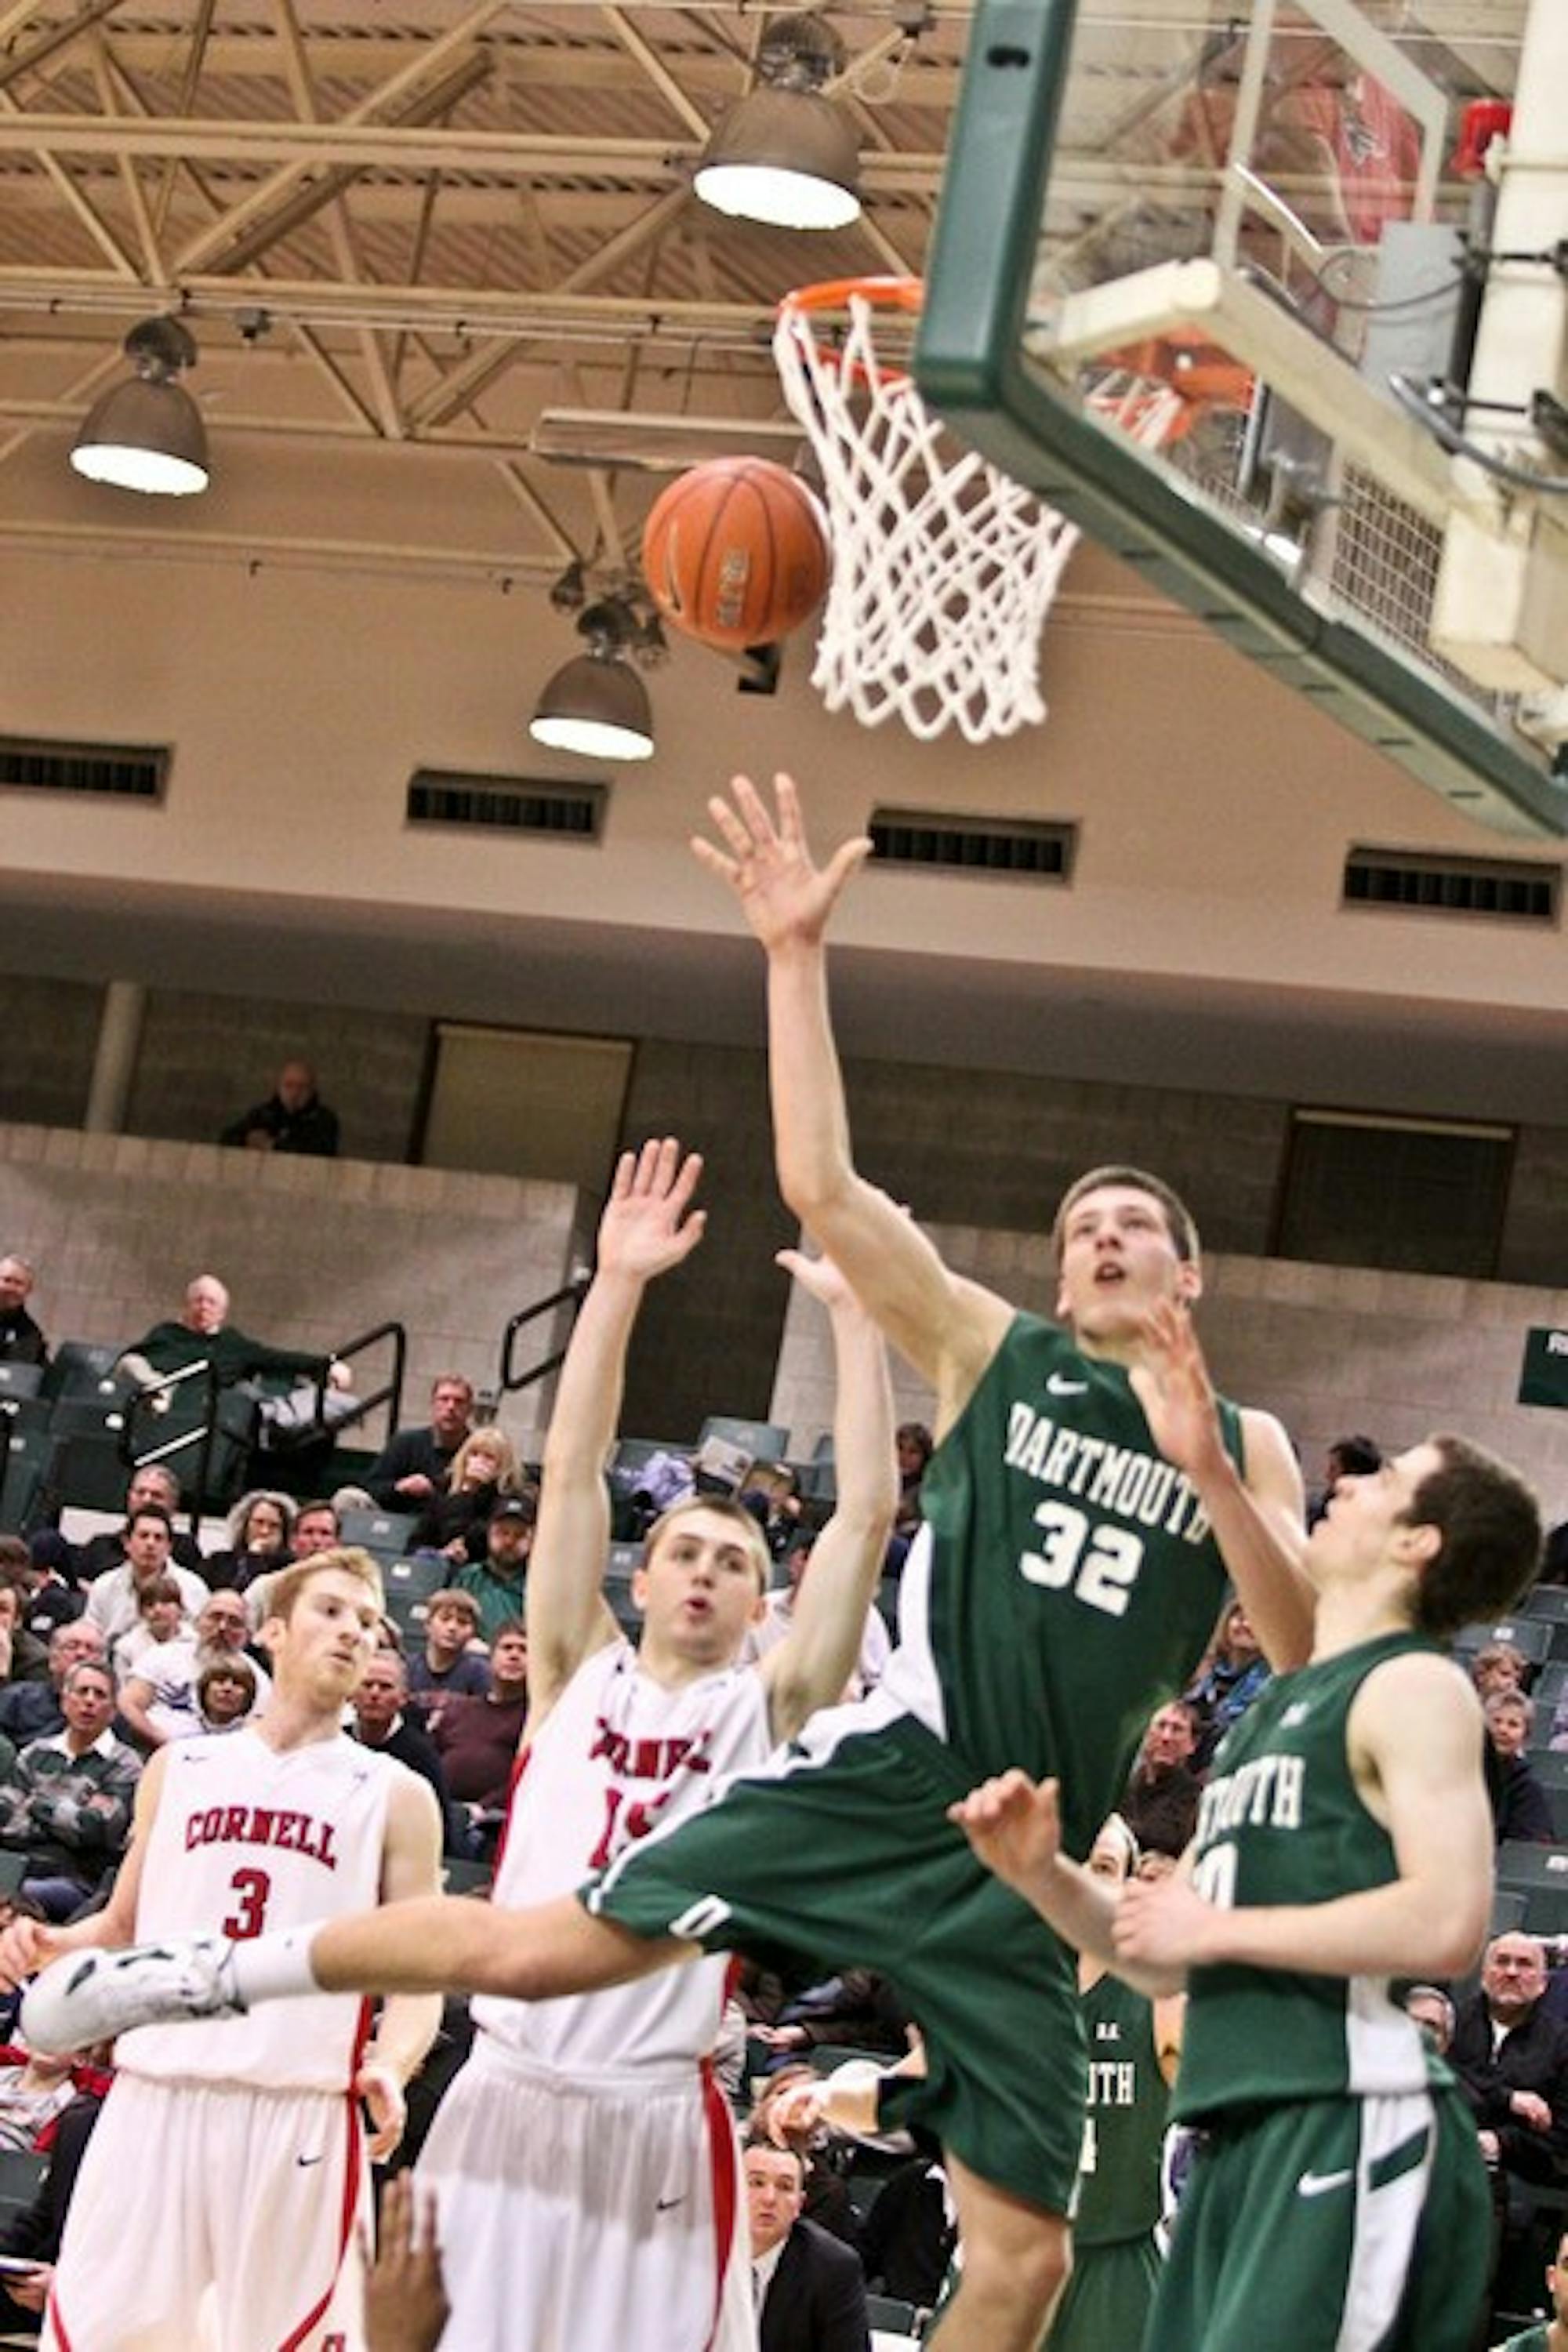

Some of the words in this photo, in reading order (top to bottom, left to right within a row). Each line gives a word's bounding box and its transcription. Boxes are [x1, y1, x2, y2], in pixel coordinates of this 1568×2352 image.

[1020, 1500, 1144, 1617] 32
[185, 1806, 337, 1871] CORNELL
[221, 1867, 270, 1941] 3
